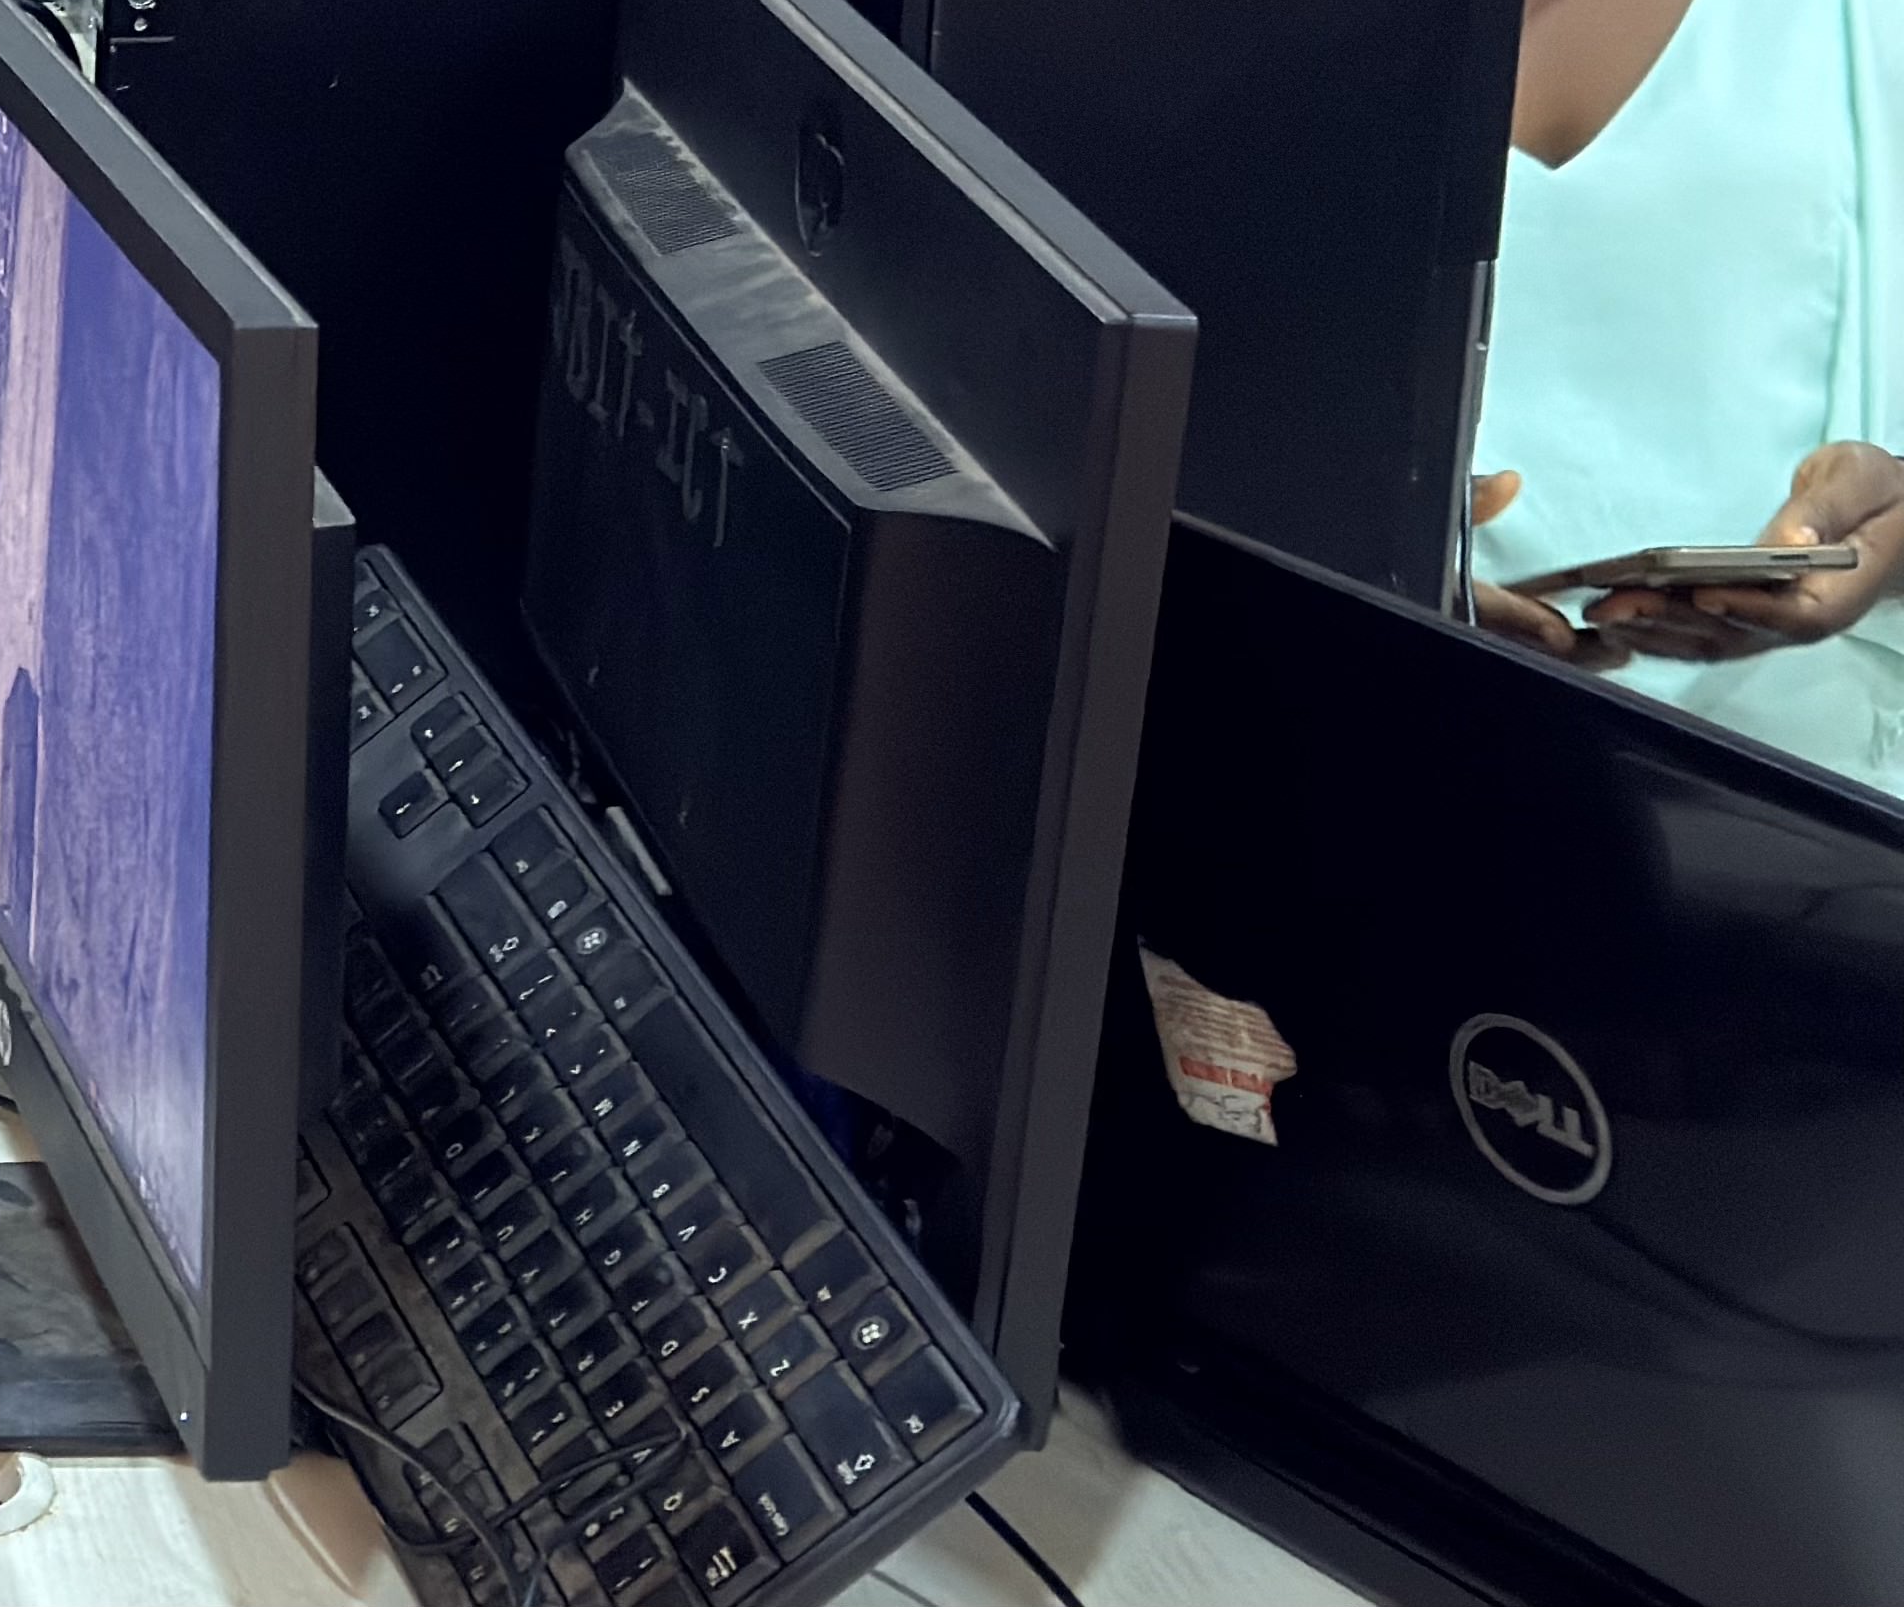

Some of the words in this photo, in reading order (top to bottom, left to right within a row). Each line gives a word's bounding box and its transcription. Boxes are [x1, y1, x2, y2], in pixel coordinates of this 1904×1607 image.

[1468, 1059, 1597, 1160] DELL
[652, 1183, 670, 1198] B
[677, 1225, 698, 1242] V
[708, 1267, 727, 1284] C
[737, 1311, 758, 1330] X
[661, 1340, 679, 1357] D
[770, 1359, 788, 1377] Z
[691, 1387, 710, 1402] S
[720, 1430, 740, 1448] A
